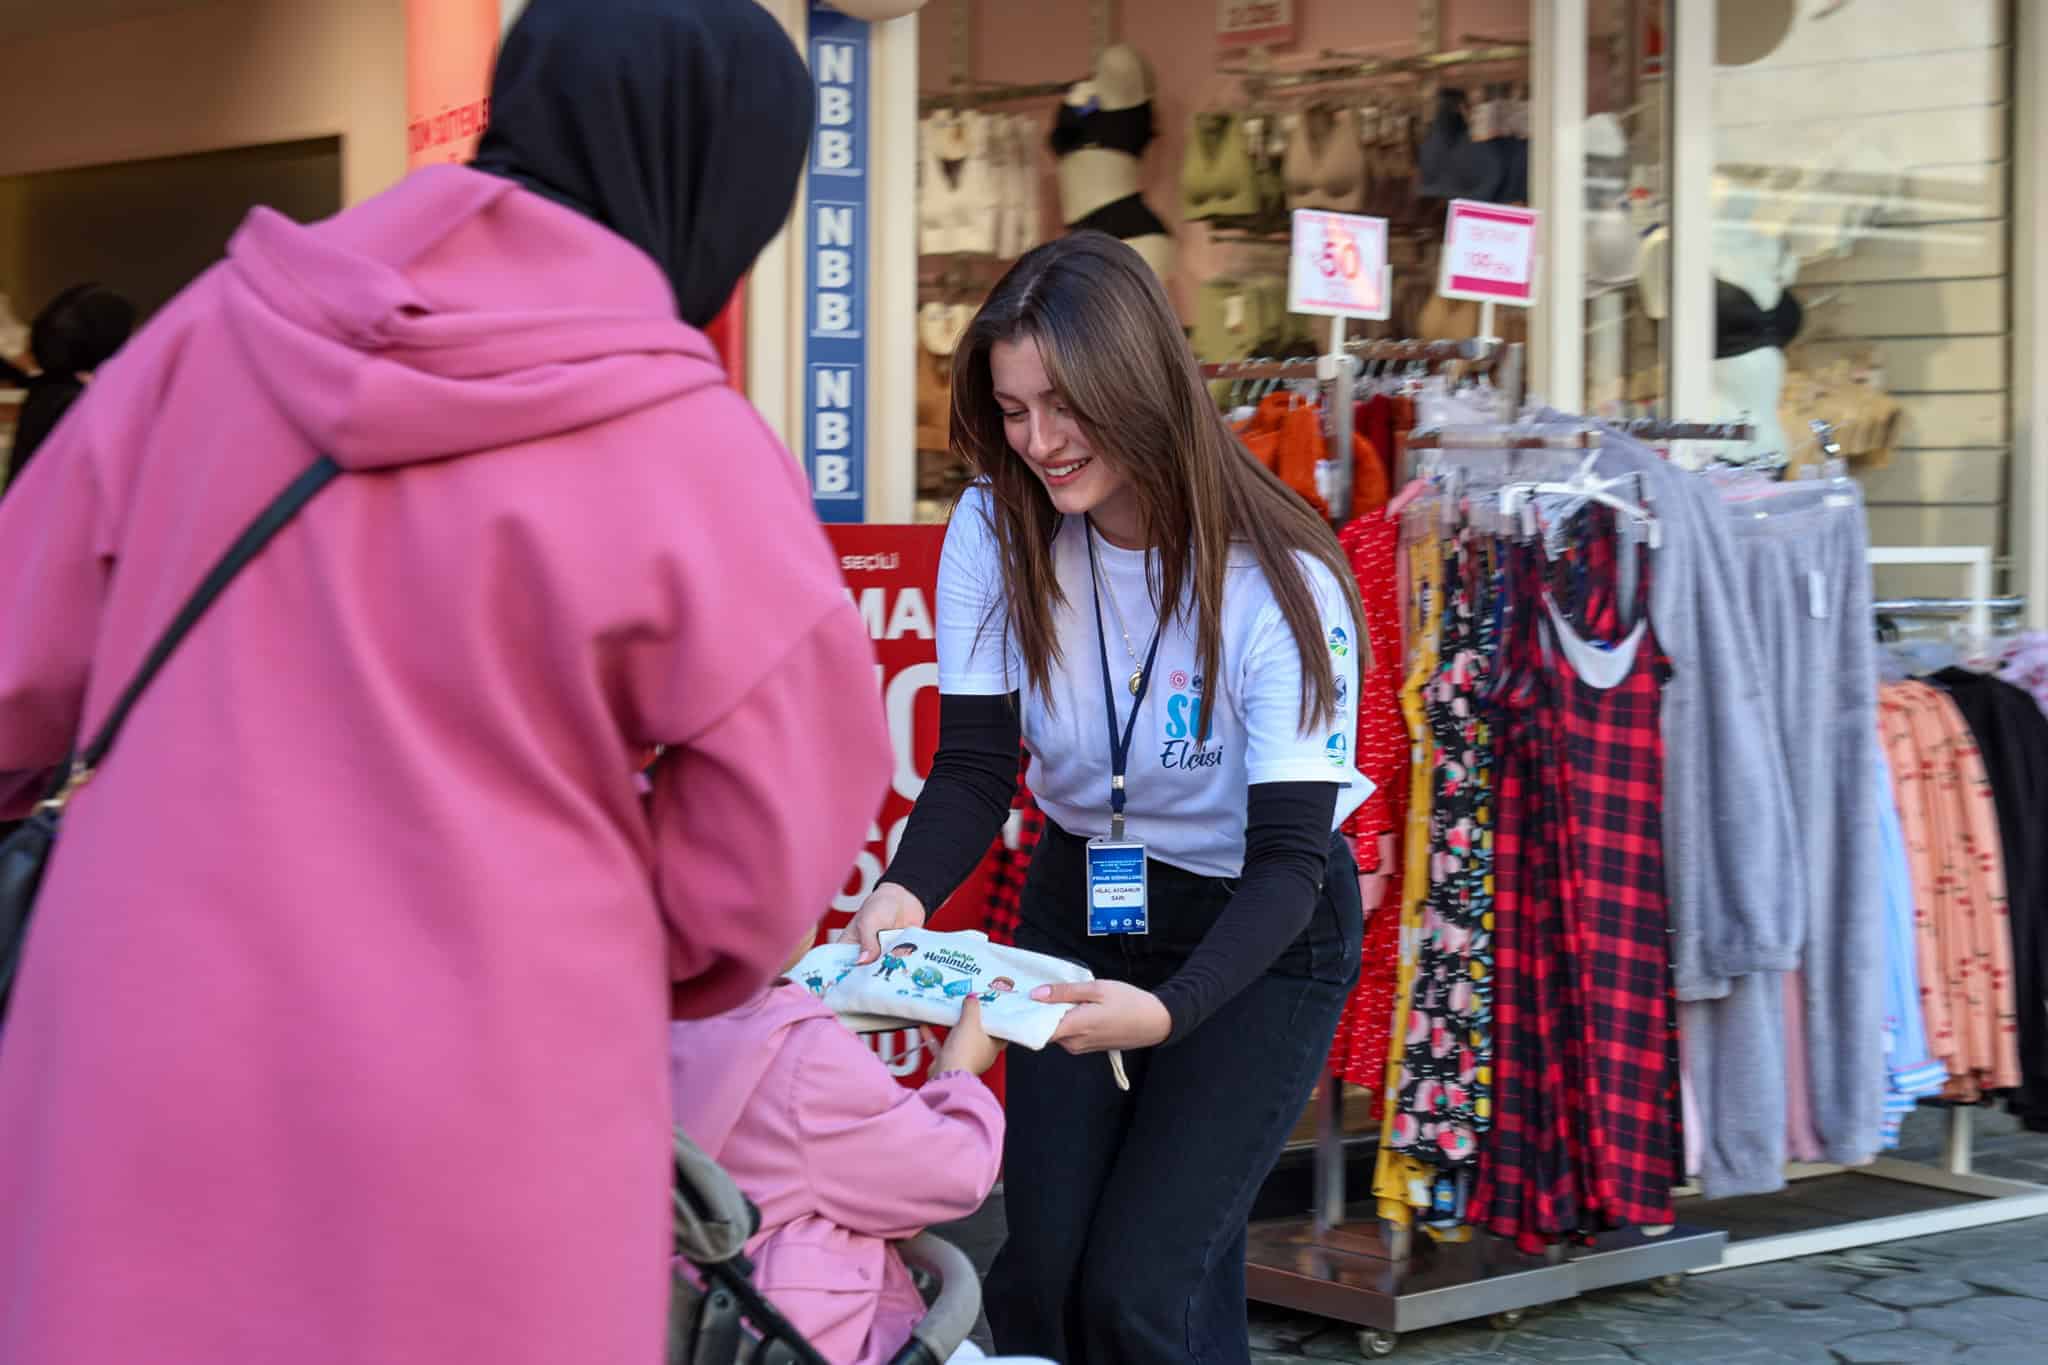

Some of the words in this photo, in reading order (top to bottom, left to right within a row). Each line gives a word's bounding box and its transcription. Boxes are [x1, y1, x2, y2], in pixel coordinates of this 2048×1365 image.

[818, 44, 854, 169] NBB
[815, 207, 853, 331] NBB
[814, 369, 852, 493] NBB
[1160, 739, 1224, 771] Elçisi
